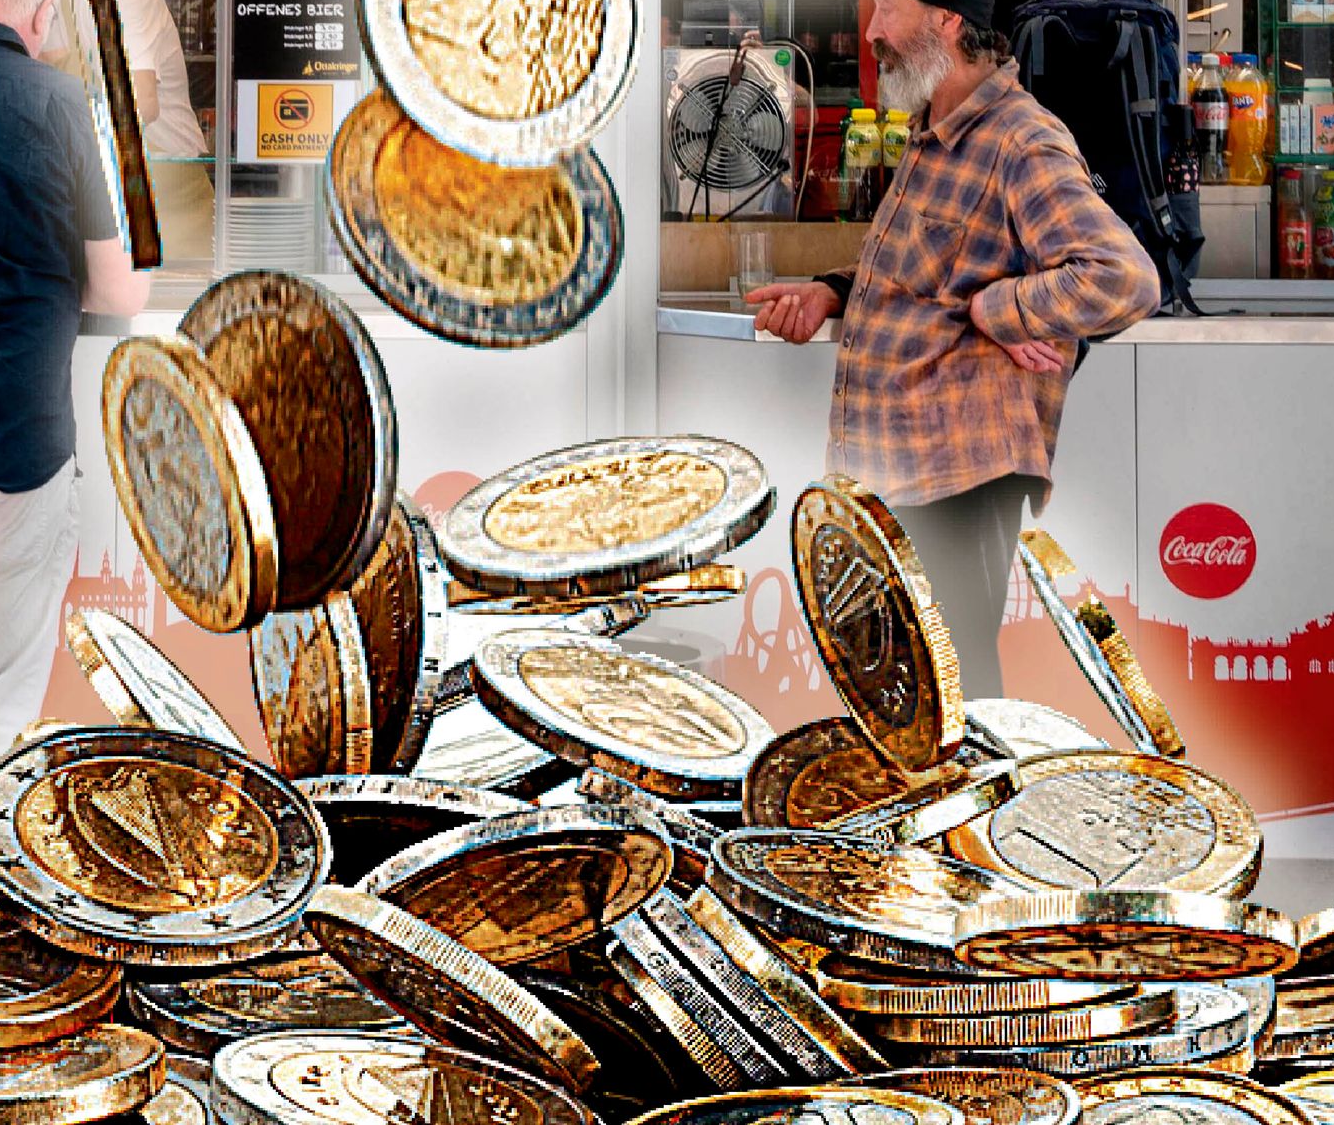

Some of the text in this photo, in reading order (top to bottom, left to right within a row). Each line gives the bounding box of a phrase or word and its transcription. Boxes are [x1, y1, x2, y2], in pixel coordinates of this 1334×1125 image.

[237, 3, 344, 17] OFFENES BIER
[261, 133, 329, 143] CASH ONLY
[1164, 535, 1252, 566] Coca-Cola
